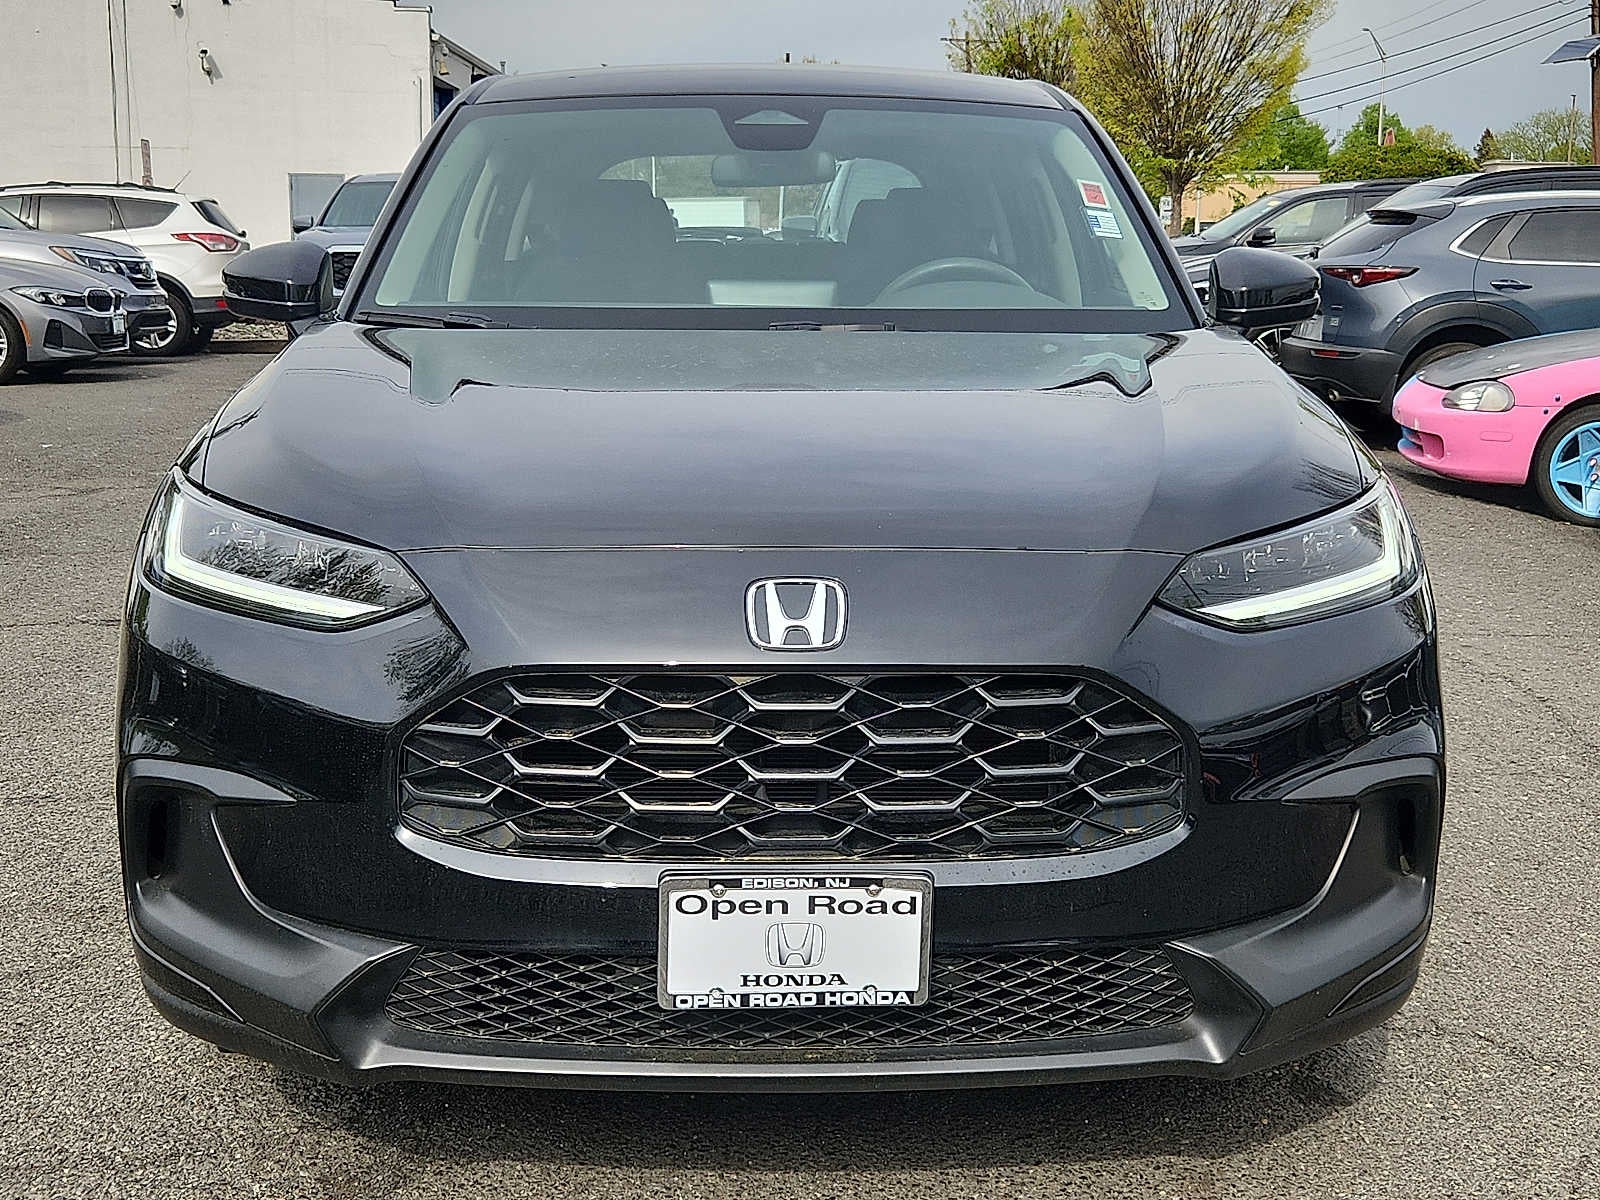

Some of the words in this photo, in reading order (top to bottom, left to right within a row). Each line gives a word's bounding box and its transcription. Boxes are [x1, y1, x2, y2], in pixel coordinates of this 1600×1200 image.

[741, 878, 819, 889] EDISON,
[825, 878, 850, 888] NJ
[675, 894, 789, 920] Open
[808, 895, 917, 915] Road
[739, 973, 849, 988] HONDA
[675, 993, 741, 1009] OPEN
[749, 992, 817, 1007] ROAD
[824, 990, 911, 1006] HONDA
